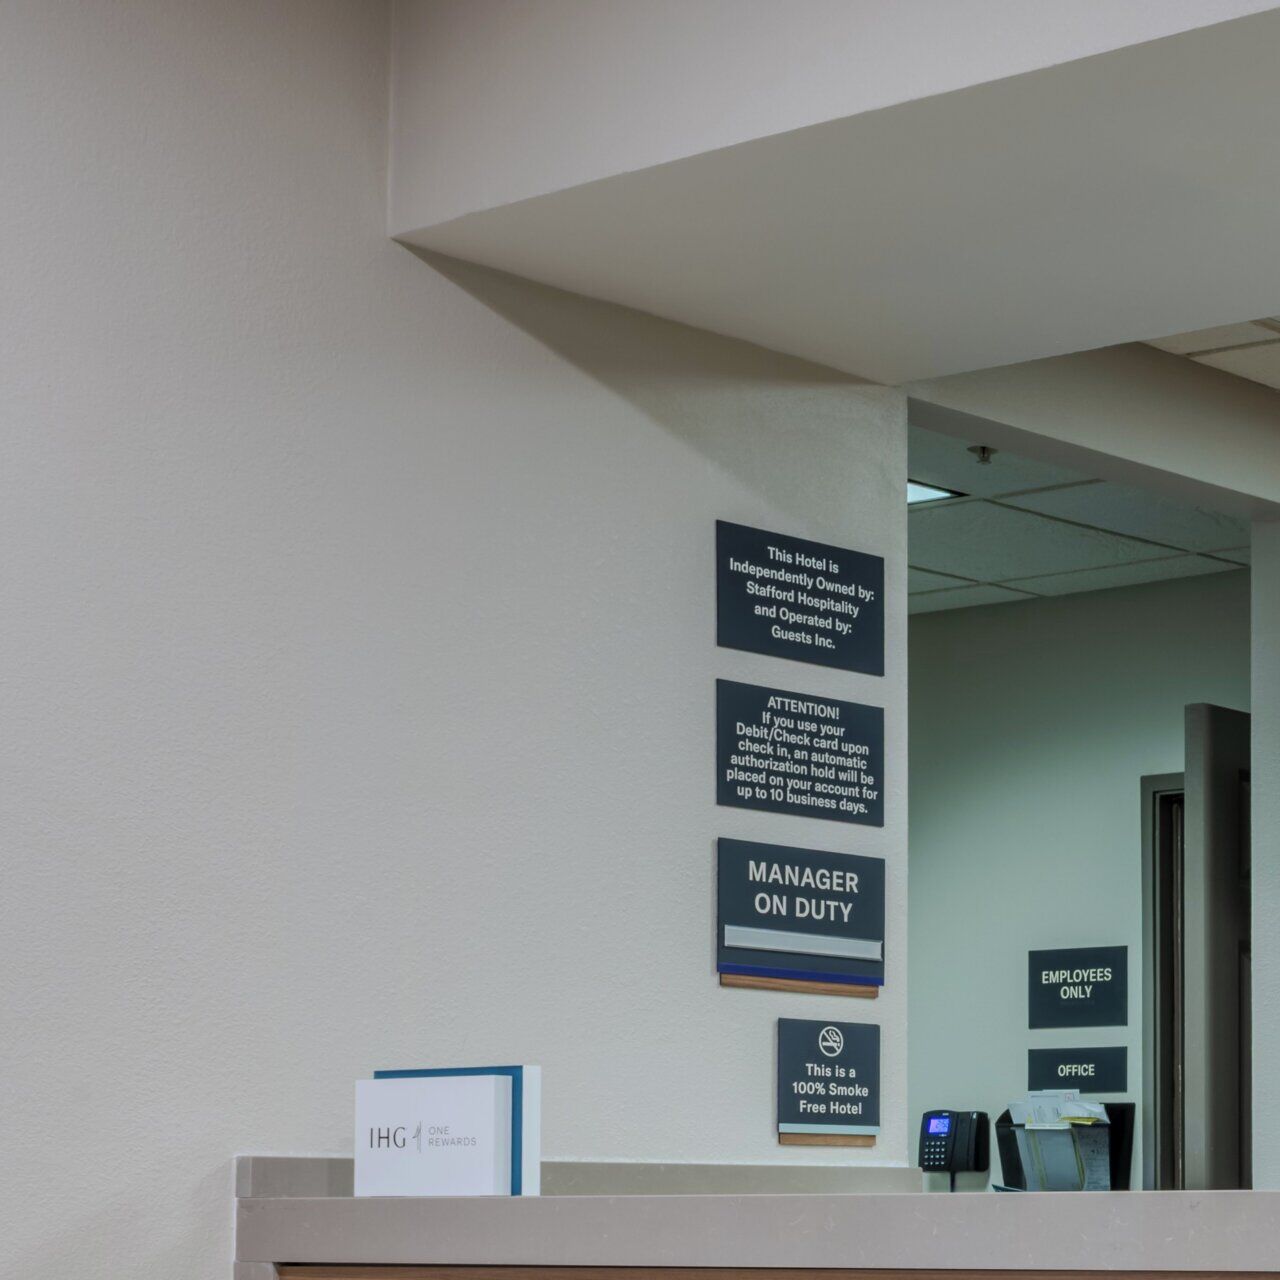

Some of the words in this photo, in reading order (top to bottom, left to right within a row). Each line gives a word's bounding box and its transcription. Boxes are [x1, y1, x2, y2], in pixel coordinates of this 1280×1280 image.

[768, 547, 792, 563] This
[796, 550, 826, 571] Hotel
[829, 560, 839, 574] is
[730, 558, 813, 589] Independently
[816, 578, 855, 597] Owned
[859, 585, 874, 600] by:
[747, 581, 794, 602] Stafford
[798, 592, 859, 618] Hospitality
[754, 604, 776, 618] and
[780, 608, 832, 630] Operated
[836, 620, 852, 634] by:
[772, 626, 812, 645] Guests
[815, 633, 836, 649] Inc.
[768, 696, 839, 719] ATTENTION!
[762, 712, 771, 724] If
[774, 716, 794, 728] you
[798, 721, 817, 732] use
[820, 724, 845, 736] your
[736, 722, 810, 745] Debit/Check
[813, 739, 838, 750] card
[842, 743, 869, 755] upon
[738, 740, 773, 754] check
[777, 745, 791, 759] in,
[794, 750, 808, 760] an
[811, 751, 867, 769] automatic
[731, 755, 807, 775] authorization
[811, 765, 835, 779] hold
[838, 770, 857, 782] will
[861, 773, 874, 785] be
[727, 769, 765, 782] placed
[769, 776, 783, 786] on
[787, 778, 812, 790] your
[815, 782, 859, 798] account
[862, 788, 878, 800] for
[737, 787, 752, 799] up
[755, 788, 767, 799] to
[770, 789, 783, 801] 10
[787, 791, 836, 809] business
[839, 799, 868, 814] days.
[749, 860, 858, 893] MANAGER
[755, 893, 786, 916] ON
[795, 897, 852, 922] DUTY
[1042, 968, 1112, 984] EMPLOYEES
[1061, 985, 1093, 999] ONLY
[805, 1063, 831, 1076] This
[835, 1065, 845, 1077] is
[849, 1069, 856, 1078] a
[1058, 1064, 1095, 1076] OFFICE
[792, 1082, 825, 1095] 100%
[829, 1083, 868, 1096] Smoke
[799, 1100, 826, 1113] Free
[830, 1101, 862, 1114] Hotel
[370, 1126, 406, 1149] IHG
[428, 1126, 449, 1135] ONE
[428, 1137, 477, 1147] REWARDS
